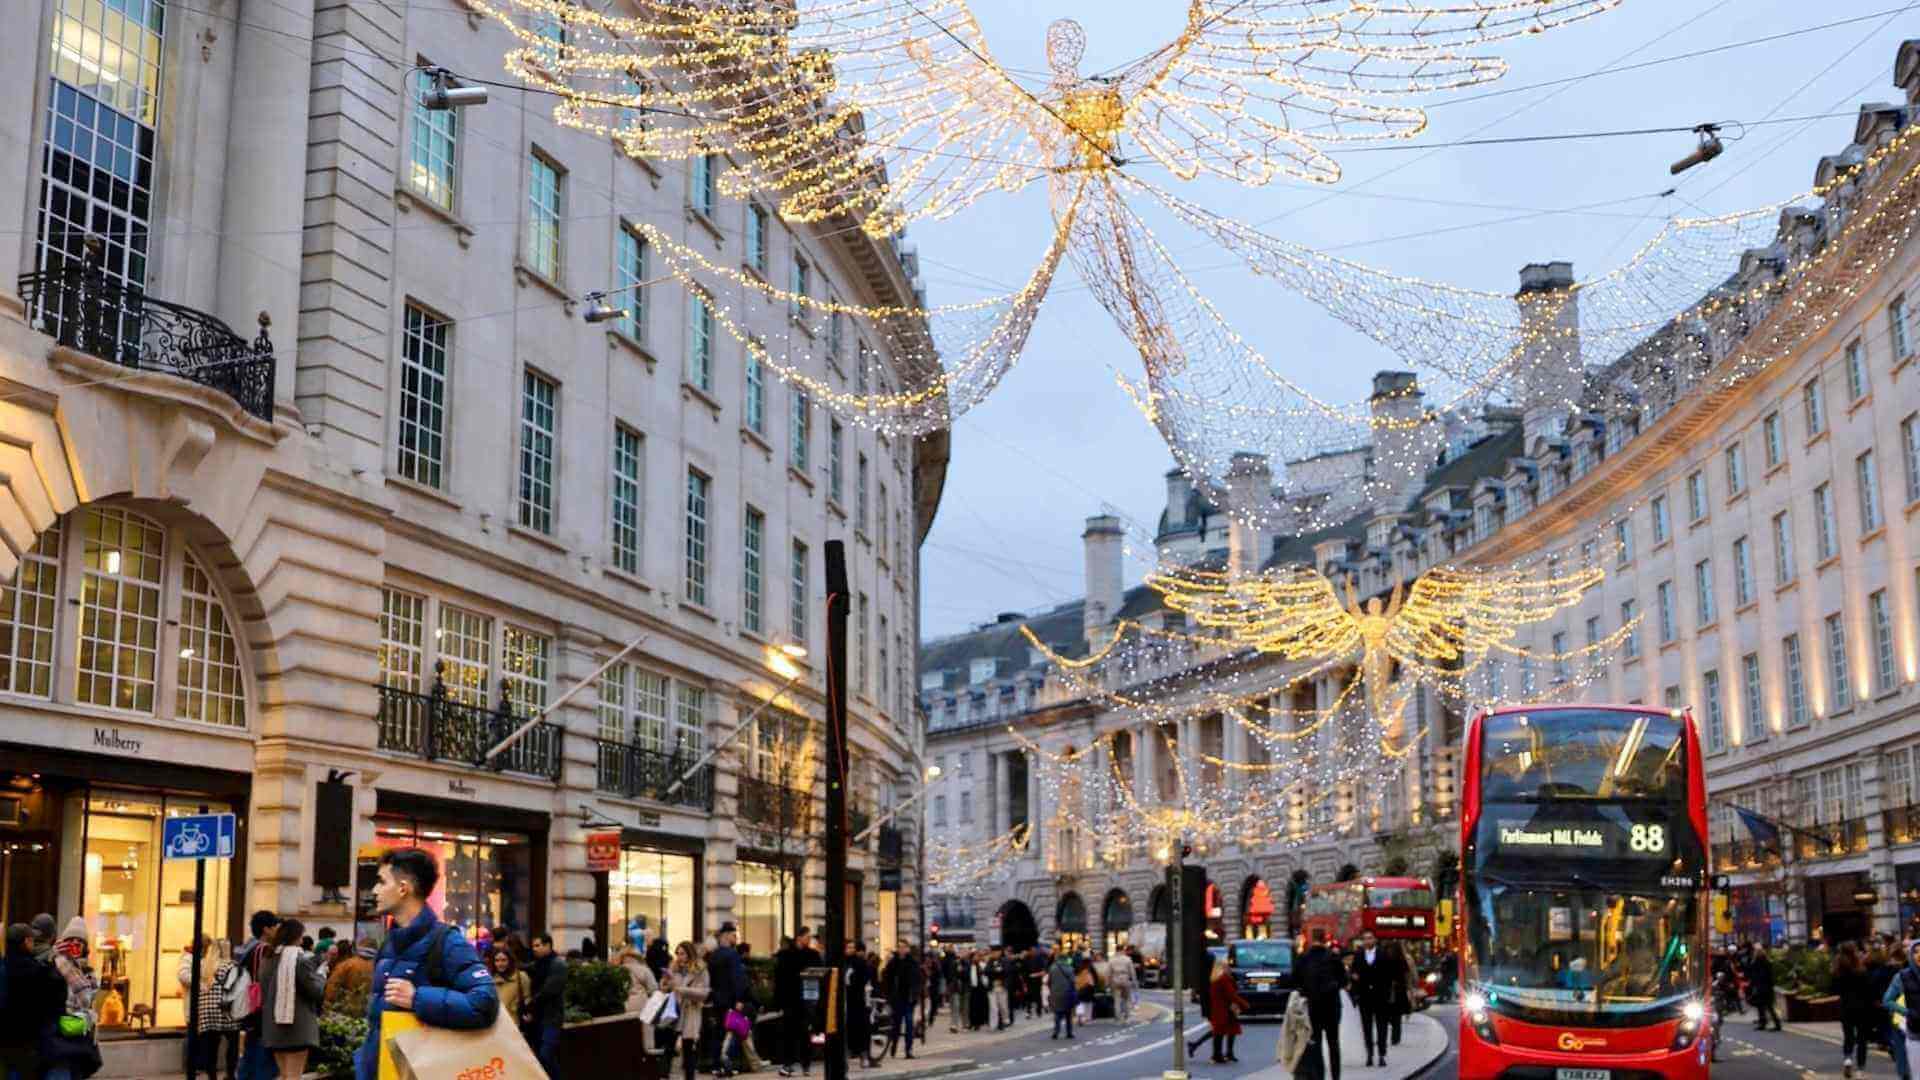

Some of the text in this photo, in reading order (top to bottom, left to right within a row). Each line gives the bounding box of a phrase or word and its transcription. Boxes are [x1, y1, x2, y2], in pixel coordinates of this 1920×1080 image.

[93, 727, 141, 754] Mulberry
[1501, 828, 1552, 845] Parliament
[1631, 823, 1665, 852] 88
